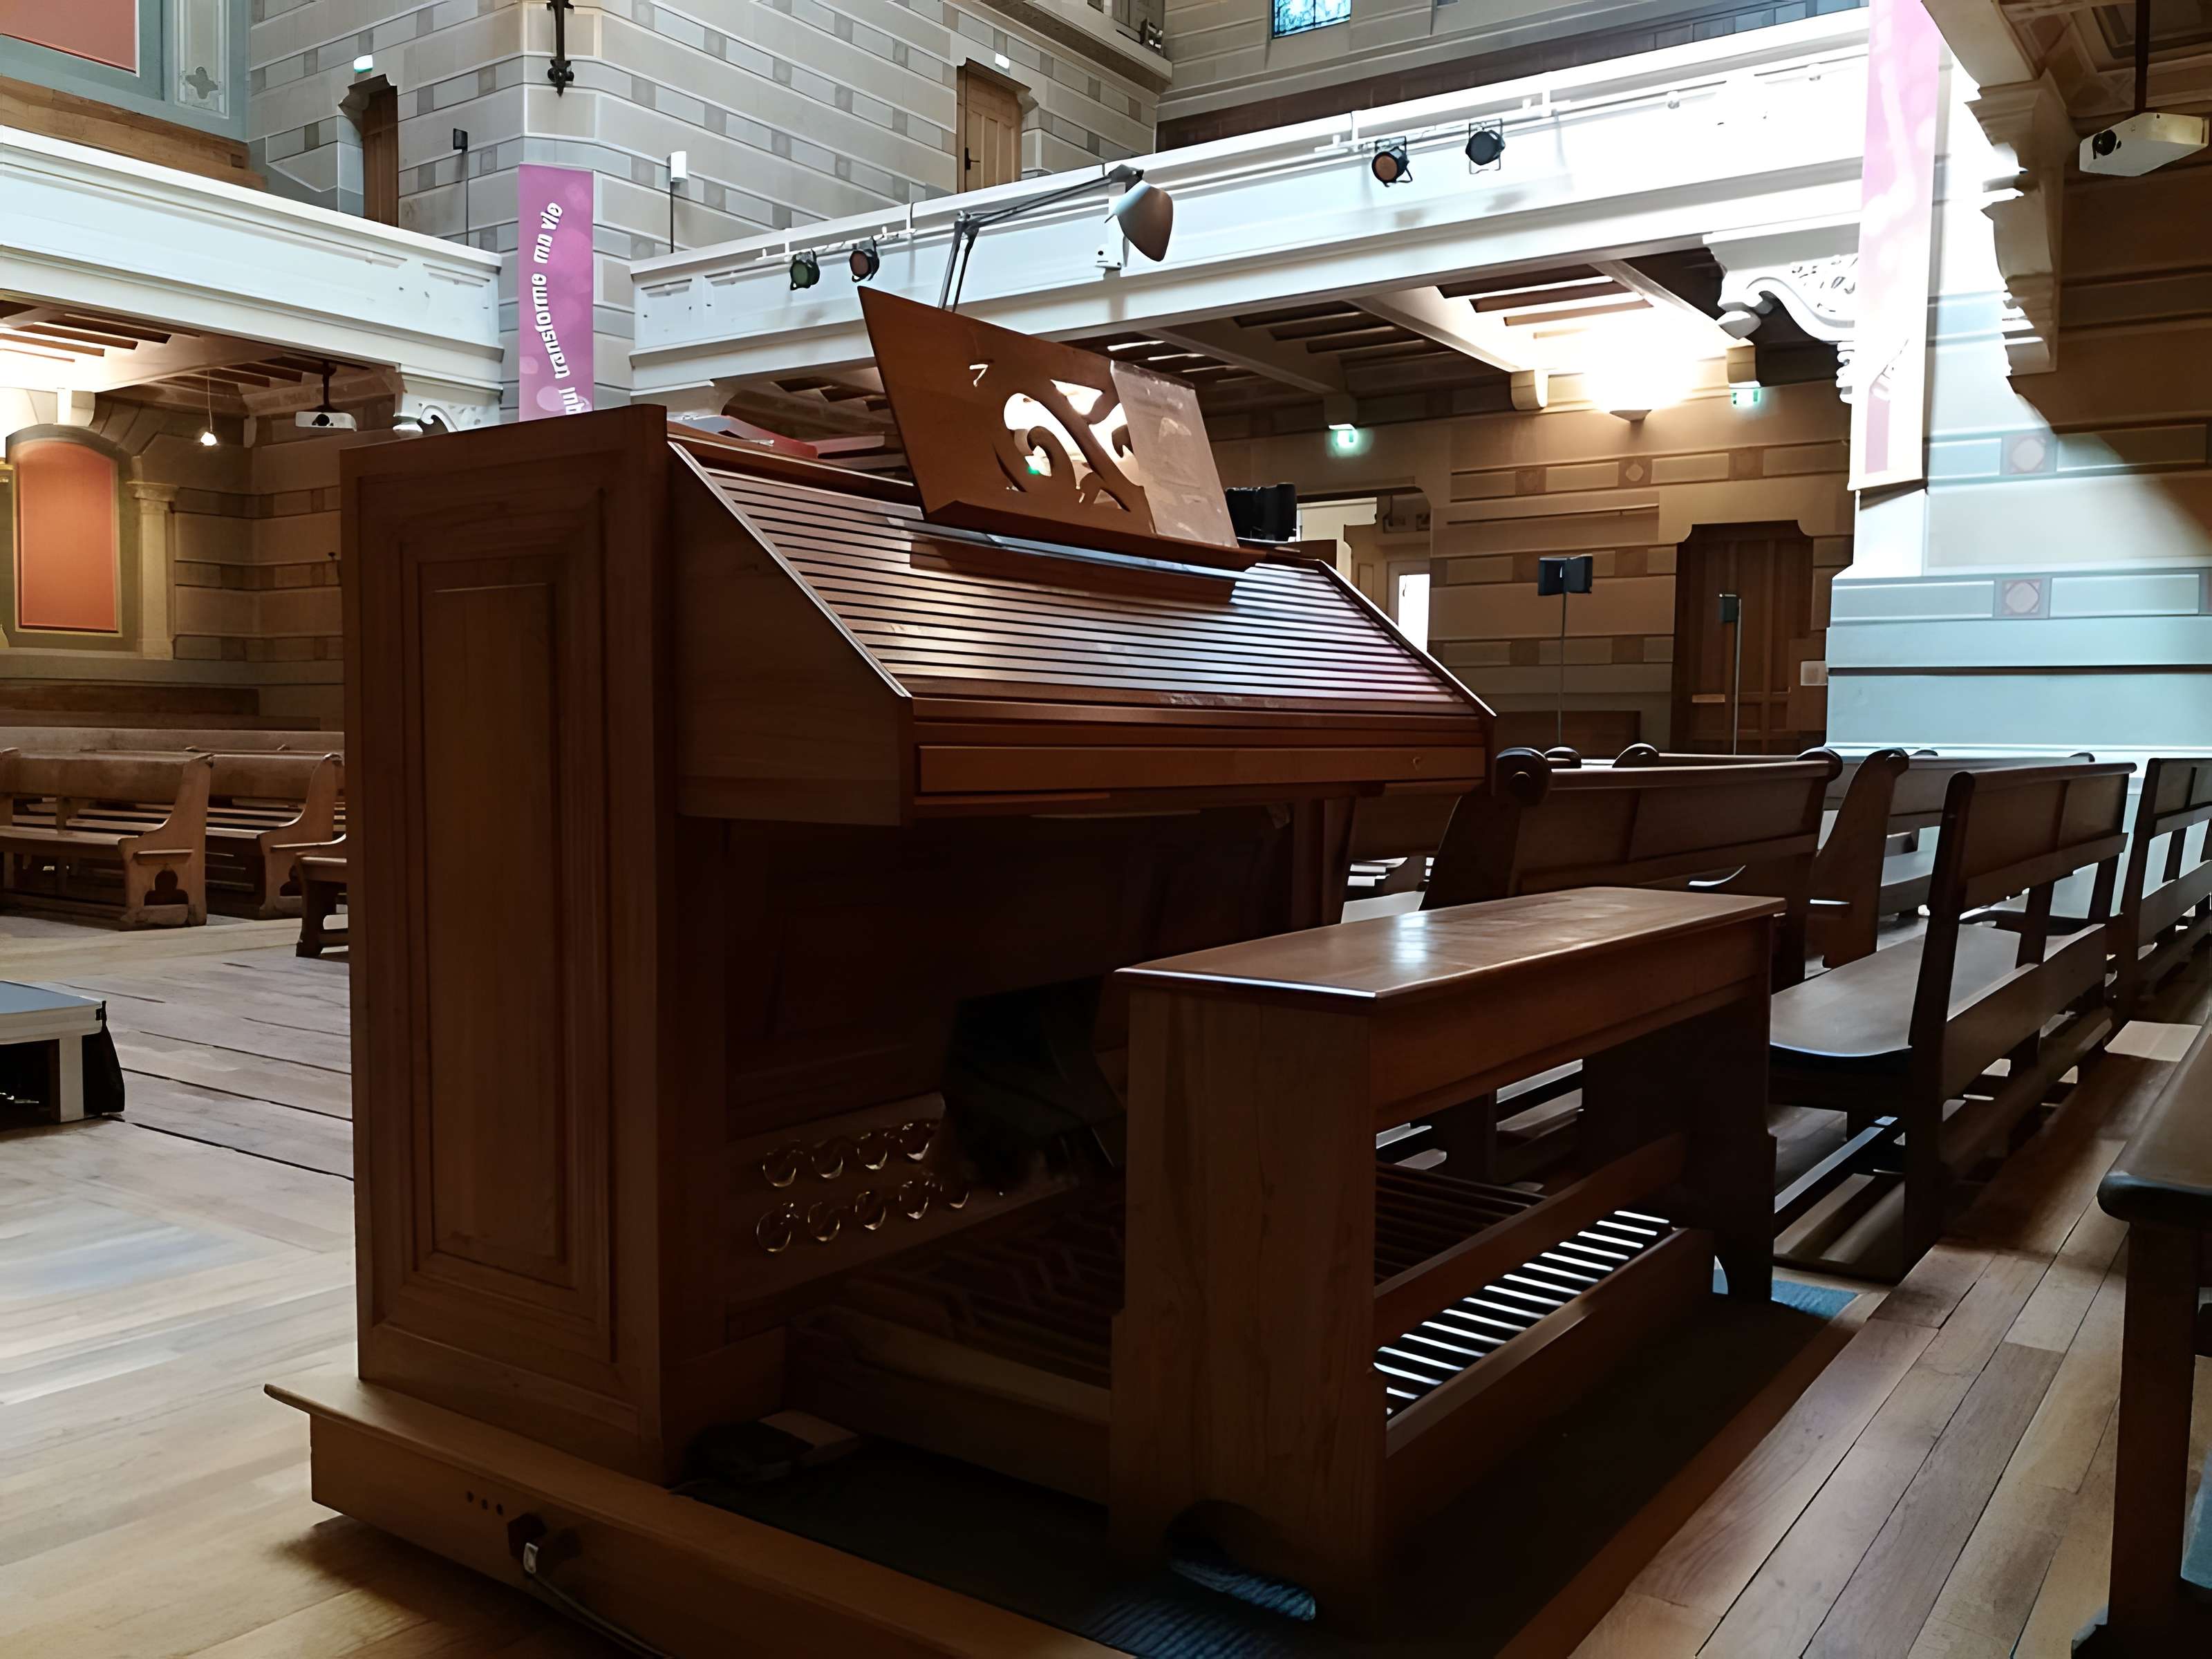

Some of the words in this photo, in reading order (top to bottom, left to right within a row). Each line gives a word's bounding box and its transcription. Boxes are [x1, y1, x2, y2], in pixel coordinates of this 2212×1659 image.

[541, 202, 563, 230] vie
[534, 234, 553, 264] ma
[532, 273, 570, 379] transforme
